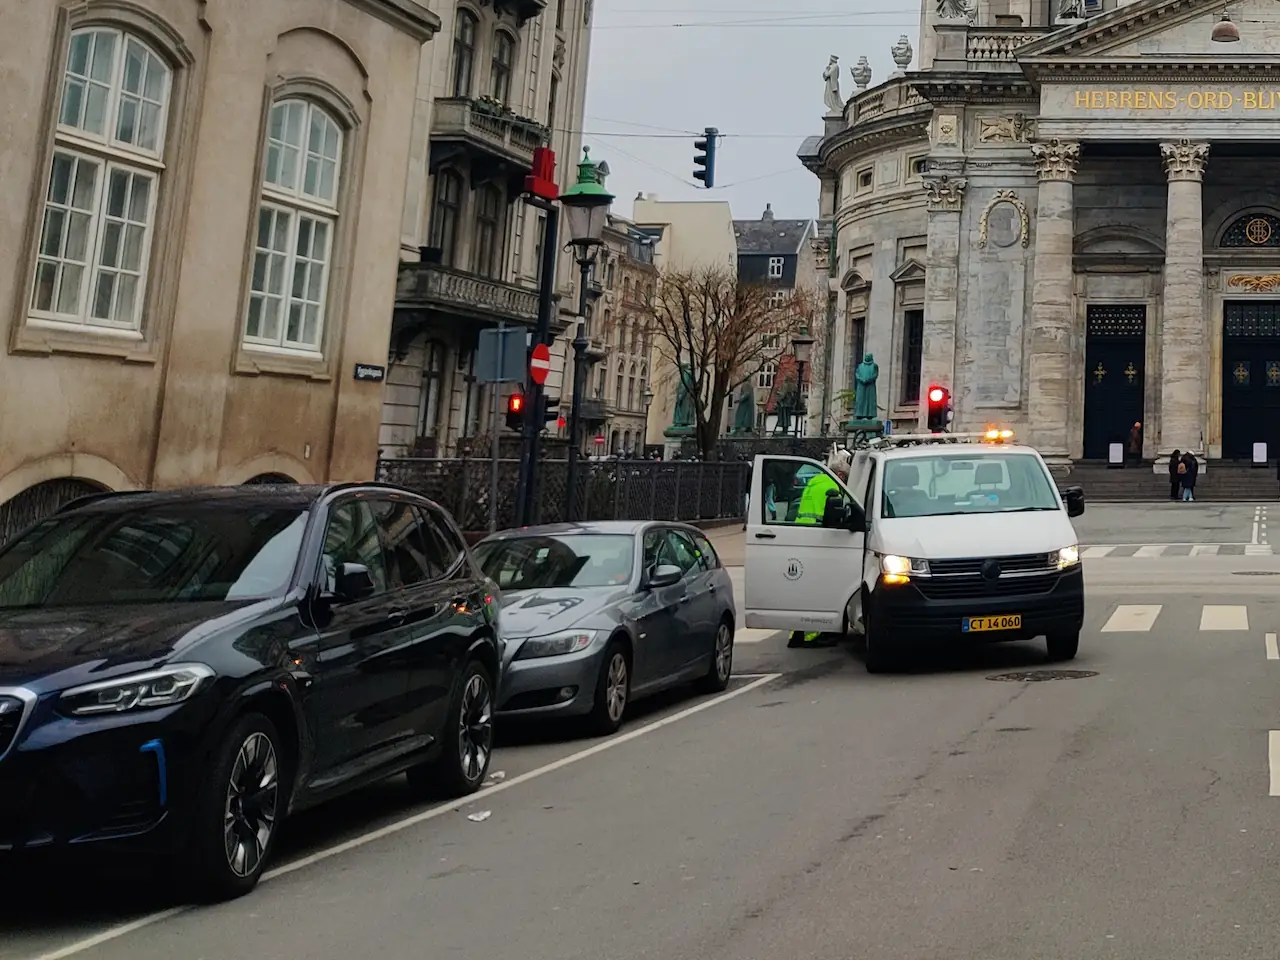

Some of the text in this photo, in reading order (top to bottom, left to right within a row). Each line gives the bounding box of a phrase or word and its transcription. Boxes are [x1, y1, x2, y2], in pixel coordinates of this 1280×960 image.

[1074, 91, 1177, 110] HERRENS
[1187, 91, 1233, 110] ORD
[970, 616, 1020, 630] CT 14 060
